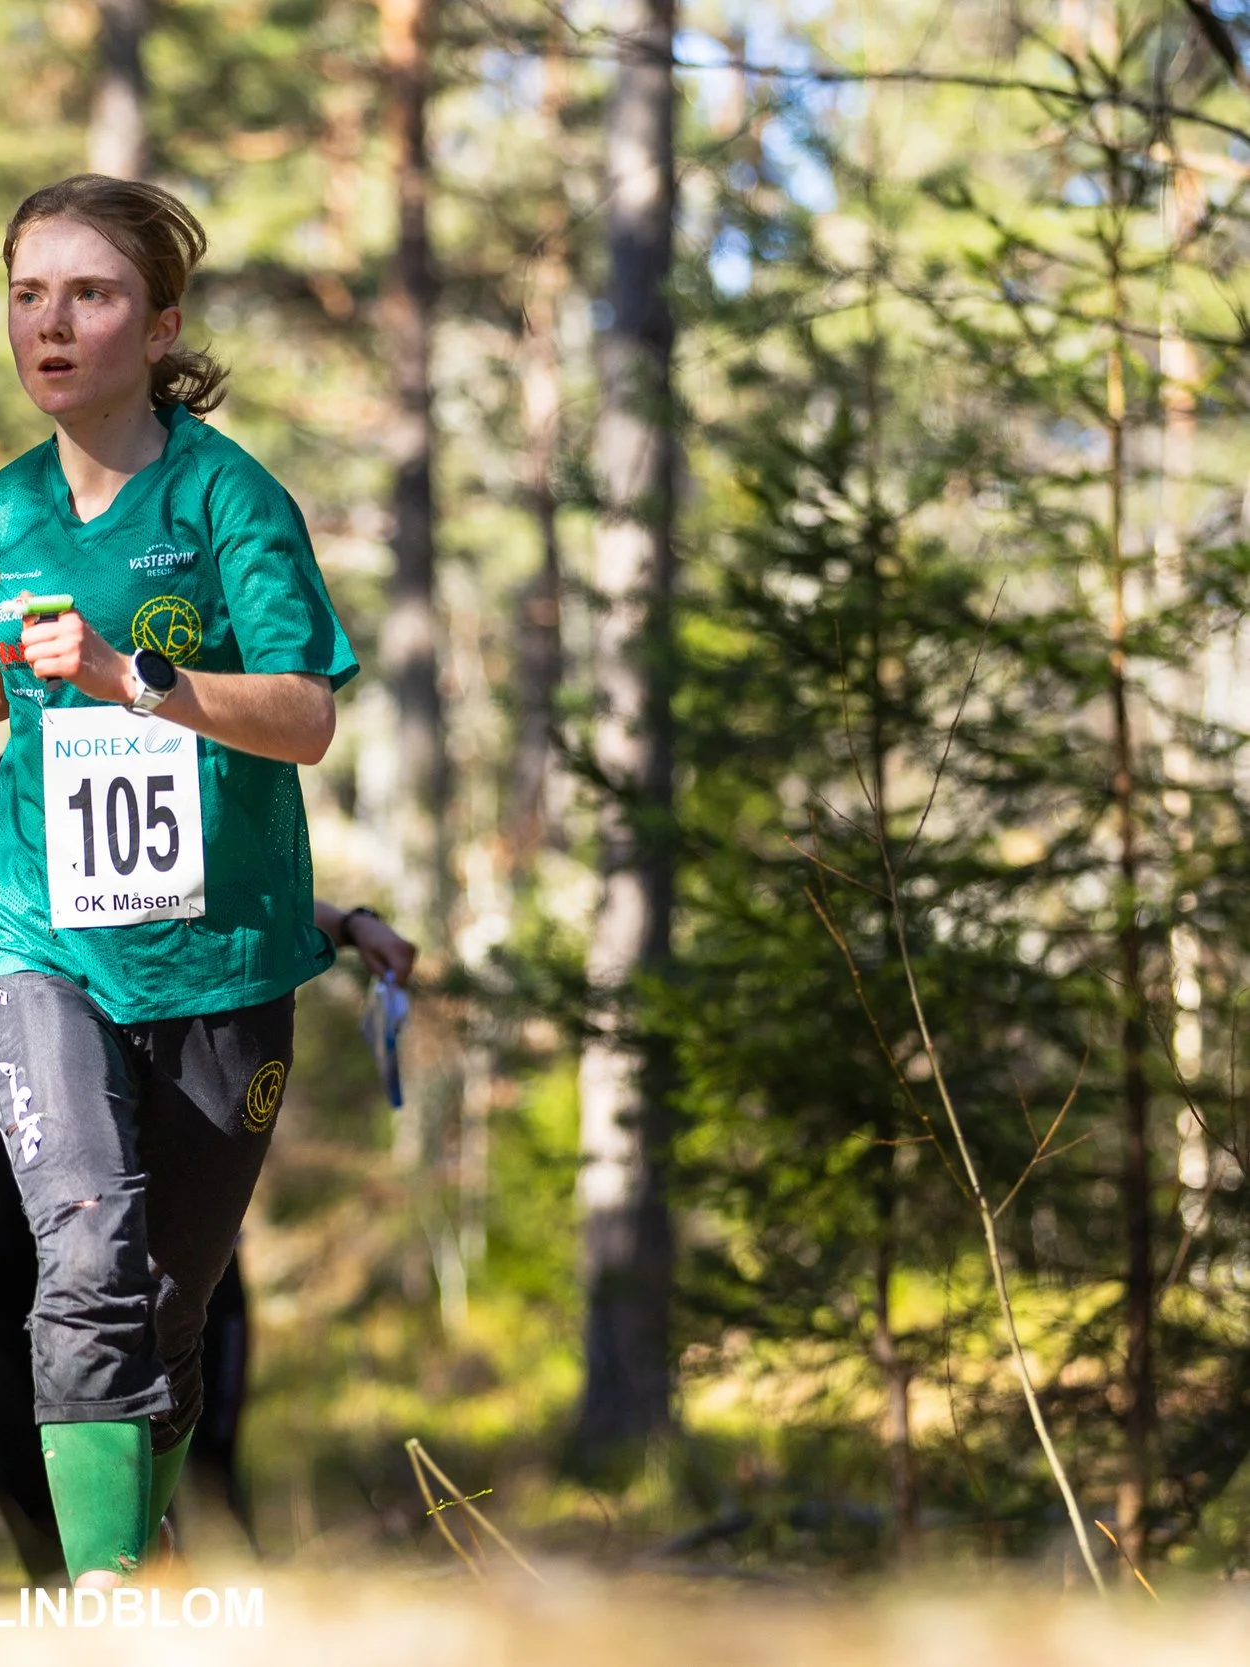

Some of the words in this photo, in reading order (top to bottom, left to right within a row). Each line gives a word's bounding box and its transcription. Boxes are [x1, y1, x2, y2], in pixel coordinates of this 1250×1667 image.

[130, 551, 195, 569] VÄSTERVIK
[147, 567, 176, 577] RESORT
[55, 736, 140, 758] NOREX
[68, 775, 180, 877] 105
[75, 895, 106, 912] OK
[113, 892, 180, 911] Måsen
